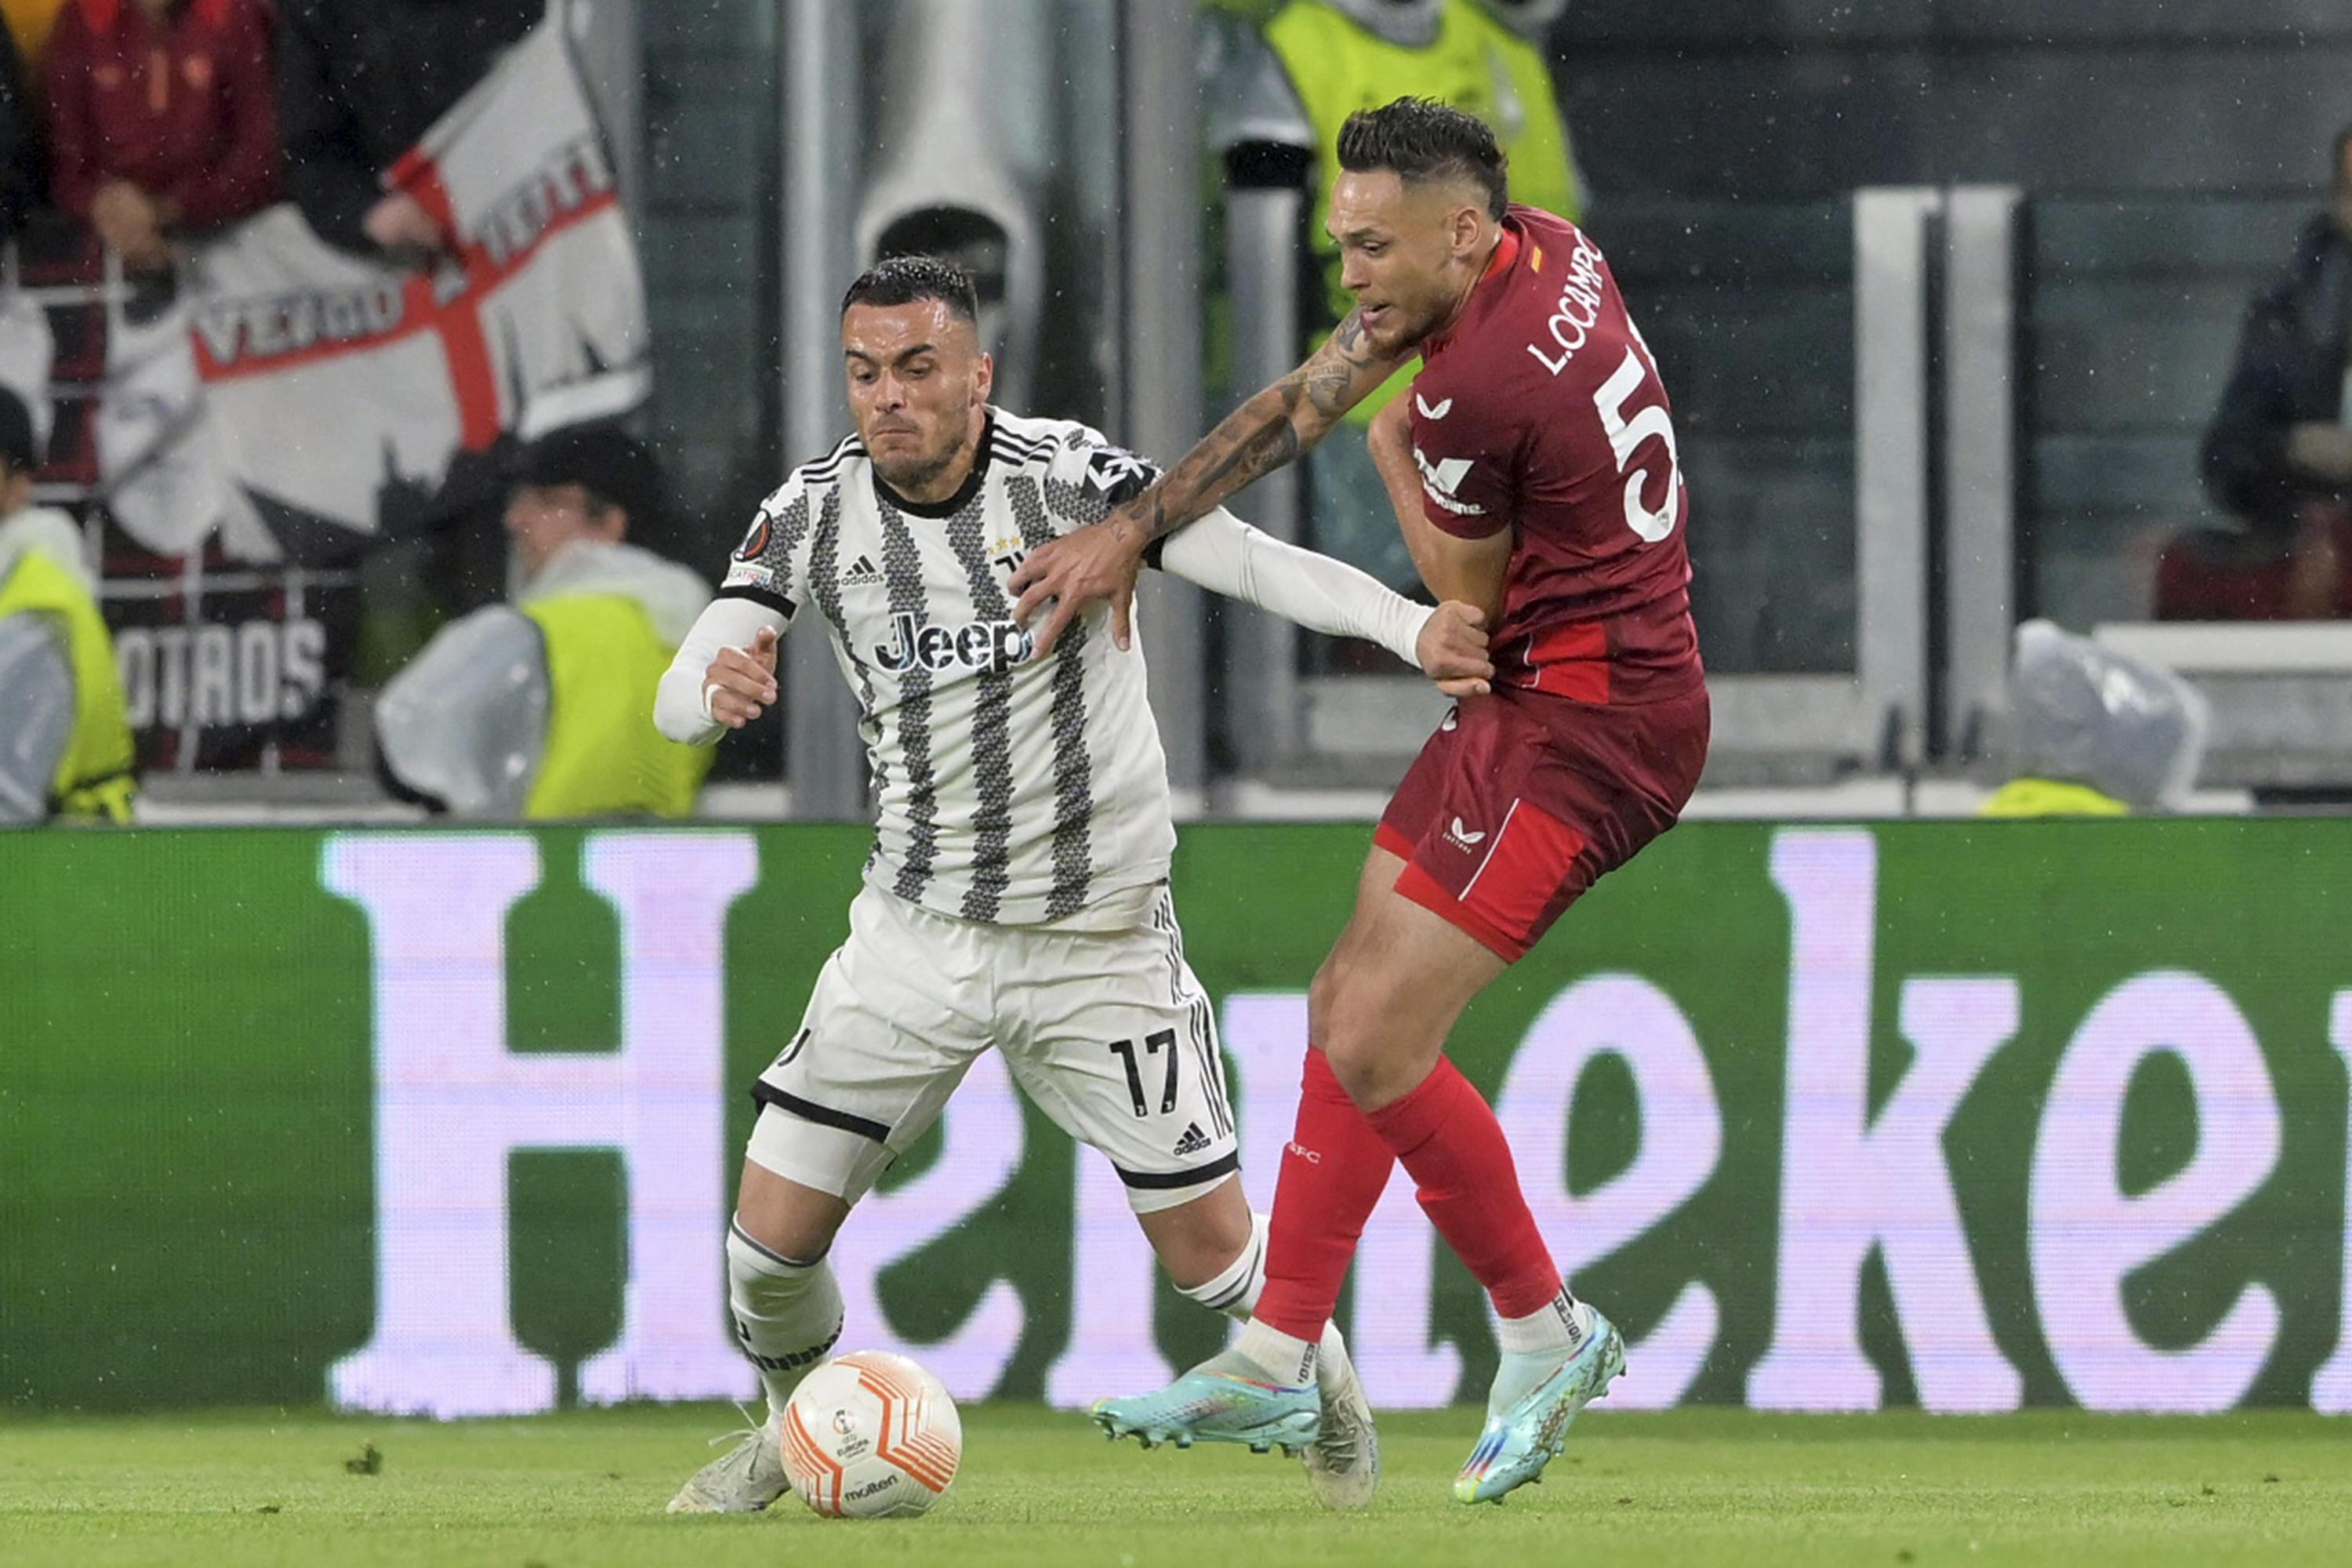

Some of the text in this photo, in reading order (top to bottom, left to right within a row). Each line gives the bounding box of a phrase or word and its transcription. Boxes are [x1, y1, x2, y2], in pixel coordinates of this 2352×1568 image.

[840, 573, 884, 586] adidas
[873, 612, 1036, 673] Jeep
[1109, 1028, 1178, 1117] 17
[1174, 1138, 1212, 1156] adidas
[845, 1475, 898, 1501] molten
